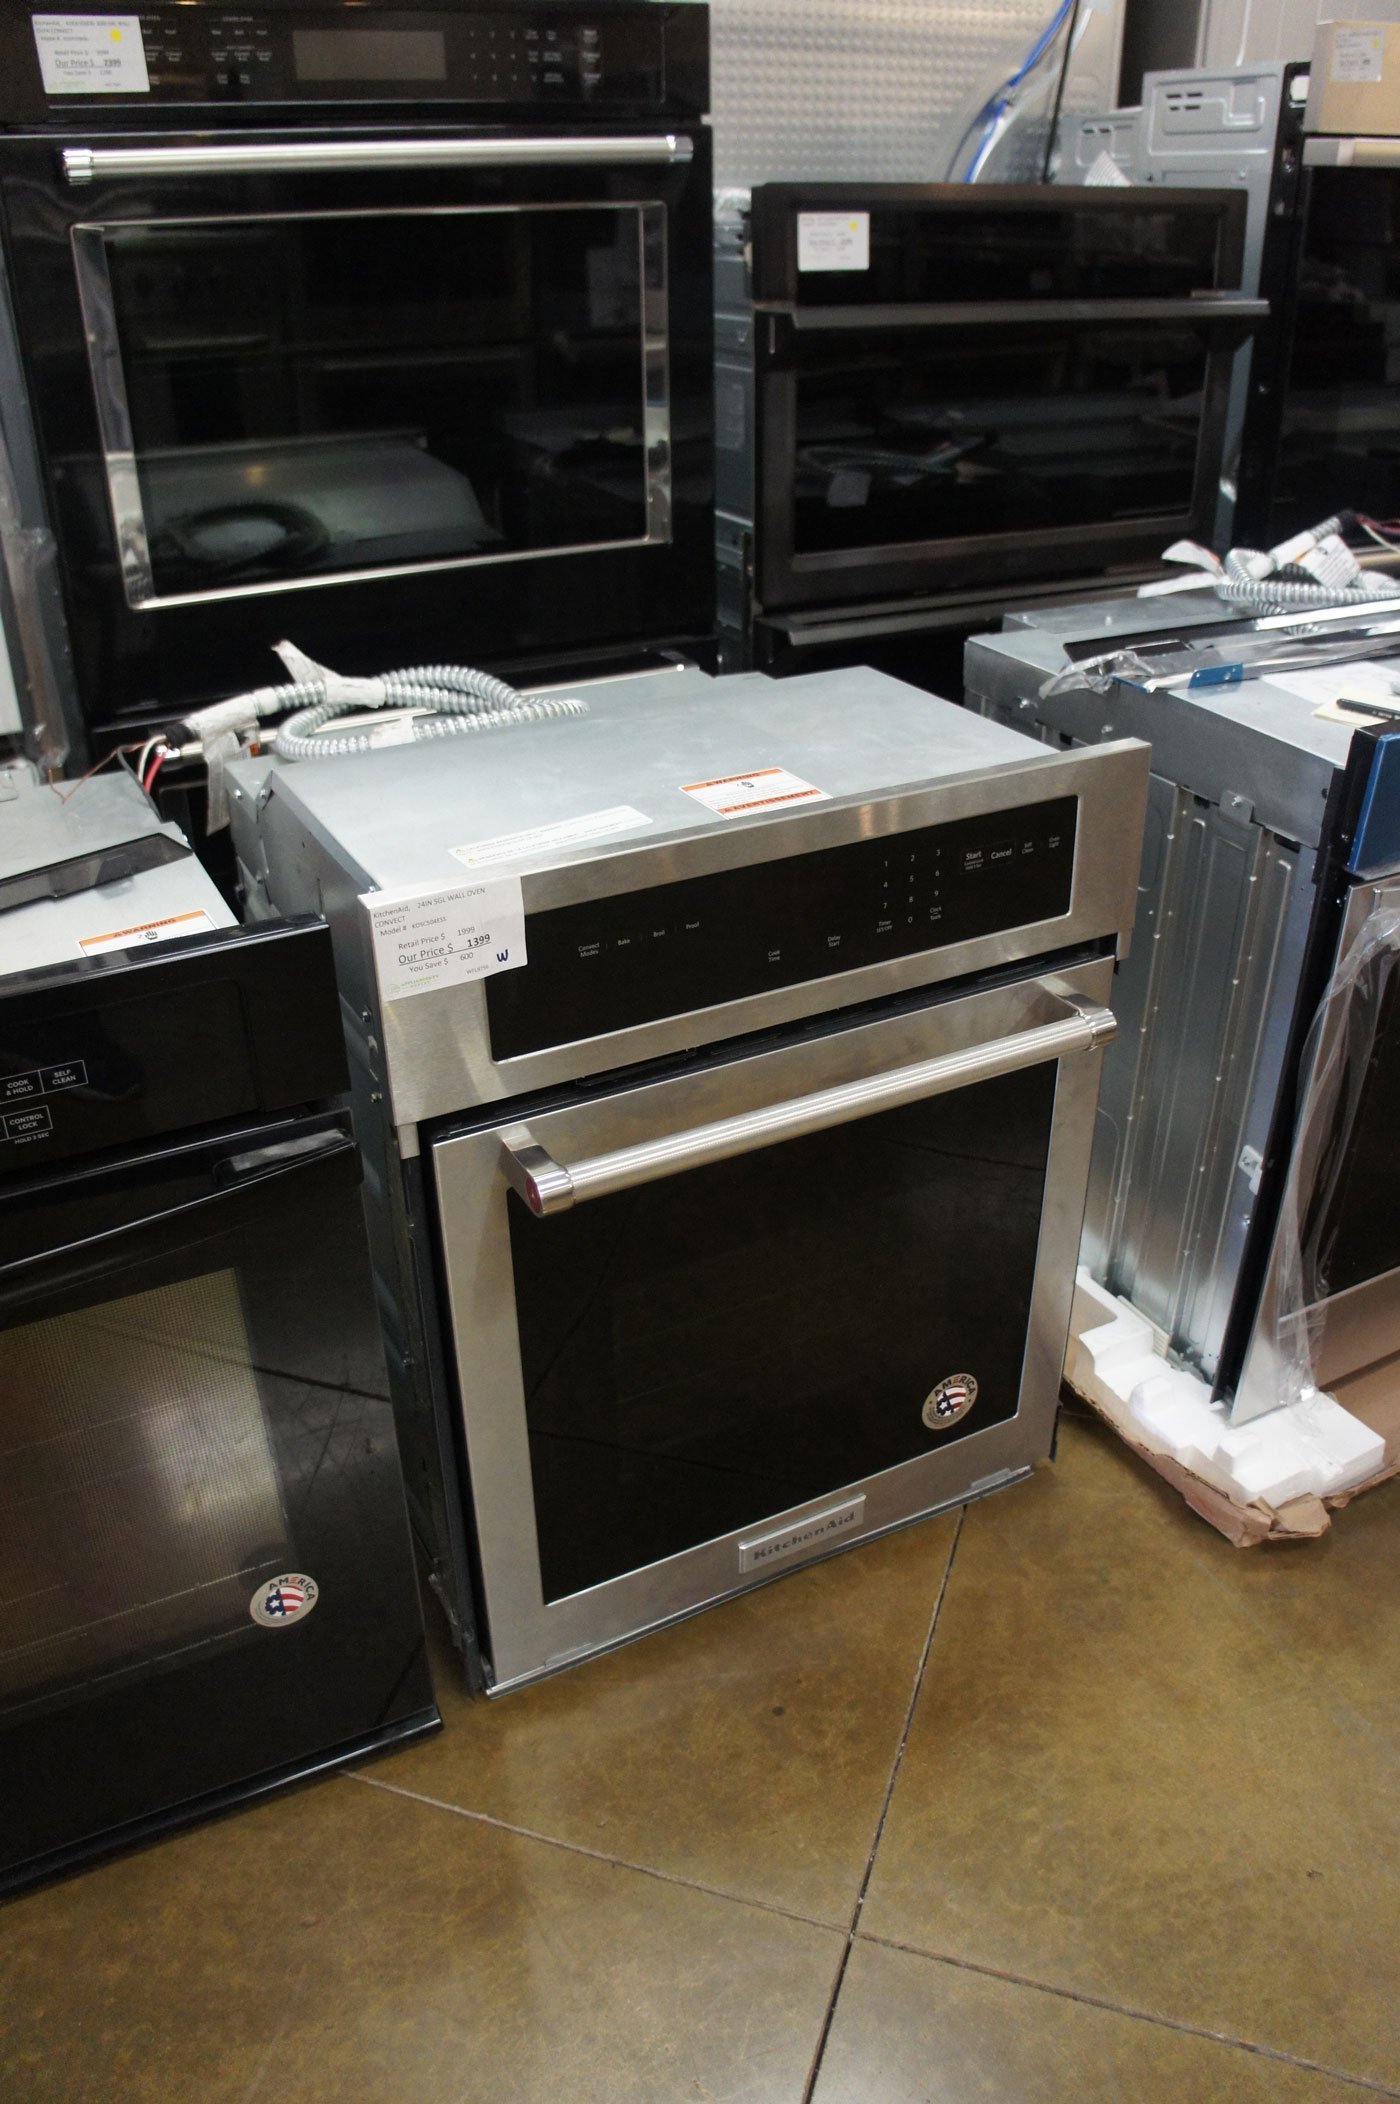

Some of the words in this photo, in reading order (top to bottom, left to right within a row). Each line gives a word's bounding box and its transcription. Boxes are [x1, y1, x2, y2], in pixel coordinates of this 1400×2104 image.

[715, 772, 761, 784] WARNING
[733, 789, 815, 810] AVERTISSEMENT
[965, 850, 982, 860] Start
[990, 848, 1012, 859] Cancel
[373, 905, 411, 919] KitchenAid,
[417, 900, 433, 909] 24IN
[434, 896, 446, 904] SGL
[447, 893, 465, 902] WALL
[466, 887, 486, 897] OVEN
[122, 918, 176, 934] WARNING
[374, 915, 406, 929] CONVECT
[685, 921, 700, 929] Proof
[380, 927, 402, 936] Model
[398, 940, 419, 950] Retail
[420, 935, 440, 945] Price
[440, 932, 446, 941] $
[457, 925, 475, 936] 1999
[398, 953, 417, 965] Our
[420, 946, 445, 958] Price
[447, 942, 454, 954] $
[466, 933, 491, 948] 1399
[578, 942, 600, 952] Convect
[580, 949, 599, 958] Modes
[409, 965, 424, 973] You
[424, 960, 442, 970] Save
[443, 957, 449, 966] $
[459, 951, 474, 961] 600
[496, 948, 509, 963] W
[52, 1075, 76, 1085] CLEAN
[53, 1069, 71, 1079] SELF
[7, 1079, 29, 1089] COOK
[13, 1085, 34, 1095] HOLD
[9, 1113, 44, 1126] CONTROL
[18, 1121, 38, 1131] LOCK
[14, 1135, 32, 1144] HOLD
[37, 1131, 50, 1139] SEC
[934, 1375, 976, 1396] AMERICA
[753, 1511, 855, 1561] KitchenAid
[269, 1576, 315, 1600] AMERICA
